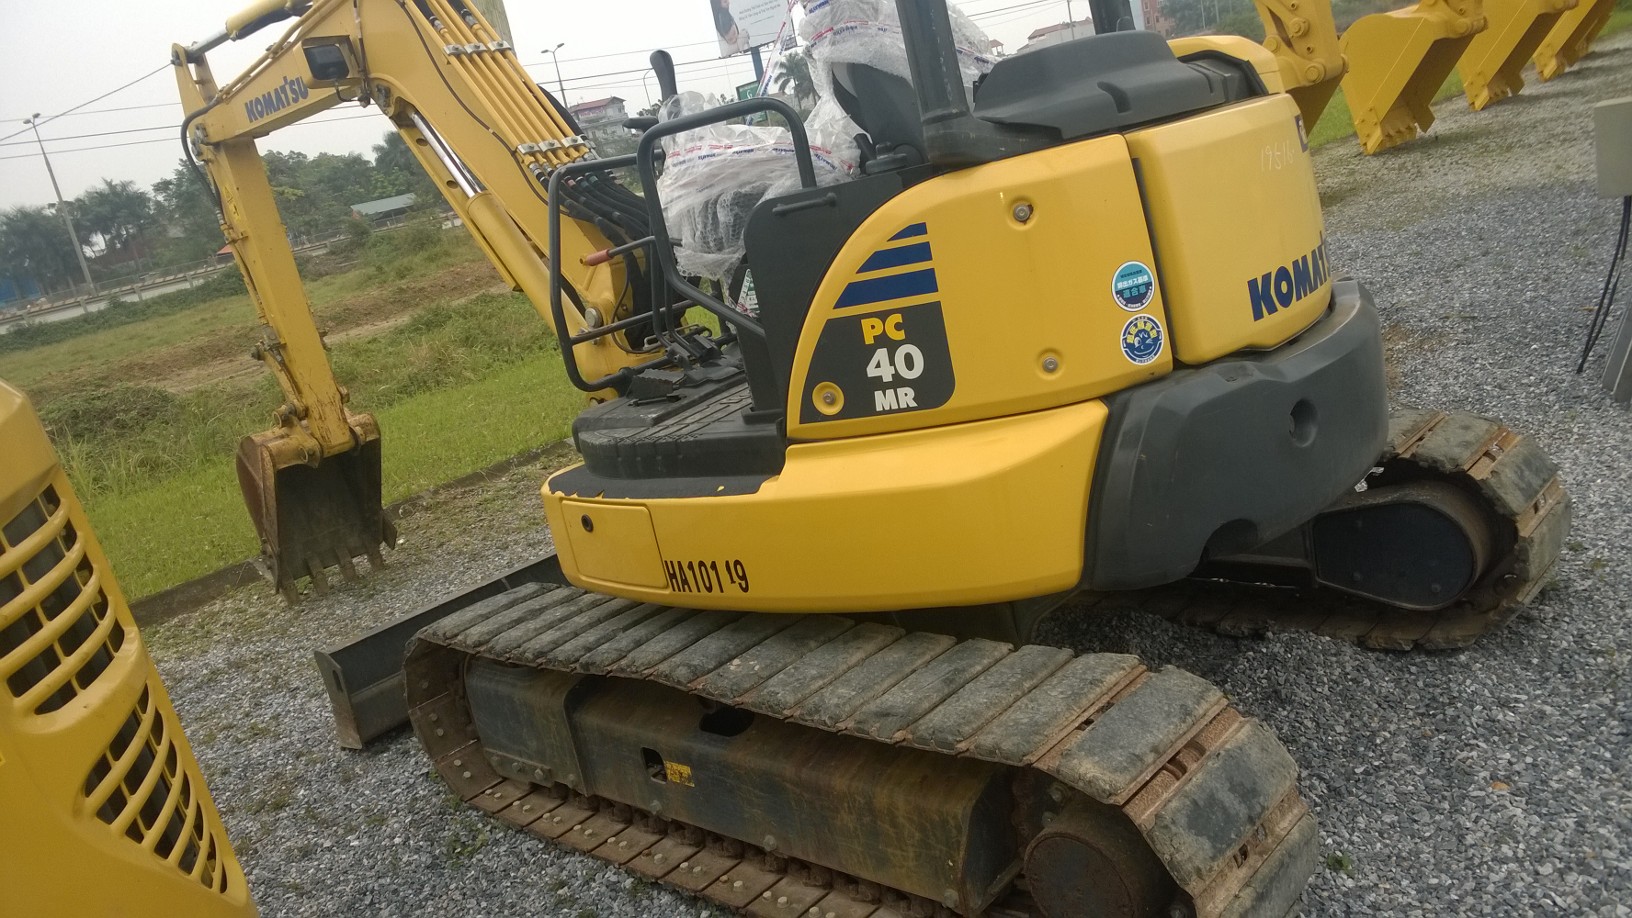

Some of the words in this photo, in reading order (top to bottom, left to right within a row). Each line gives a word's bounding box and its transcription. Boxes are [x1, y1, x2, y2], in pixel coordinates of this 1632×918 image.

[244, 75, 309, 123] KOMATSU
[1247, 230, 1330, 322] KOMAT
[860, 313, 906, 345] PC
[866, 343, 925, 383] 40
[873, 386, 918, 412] MR
